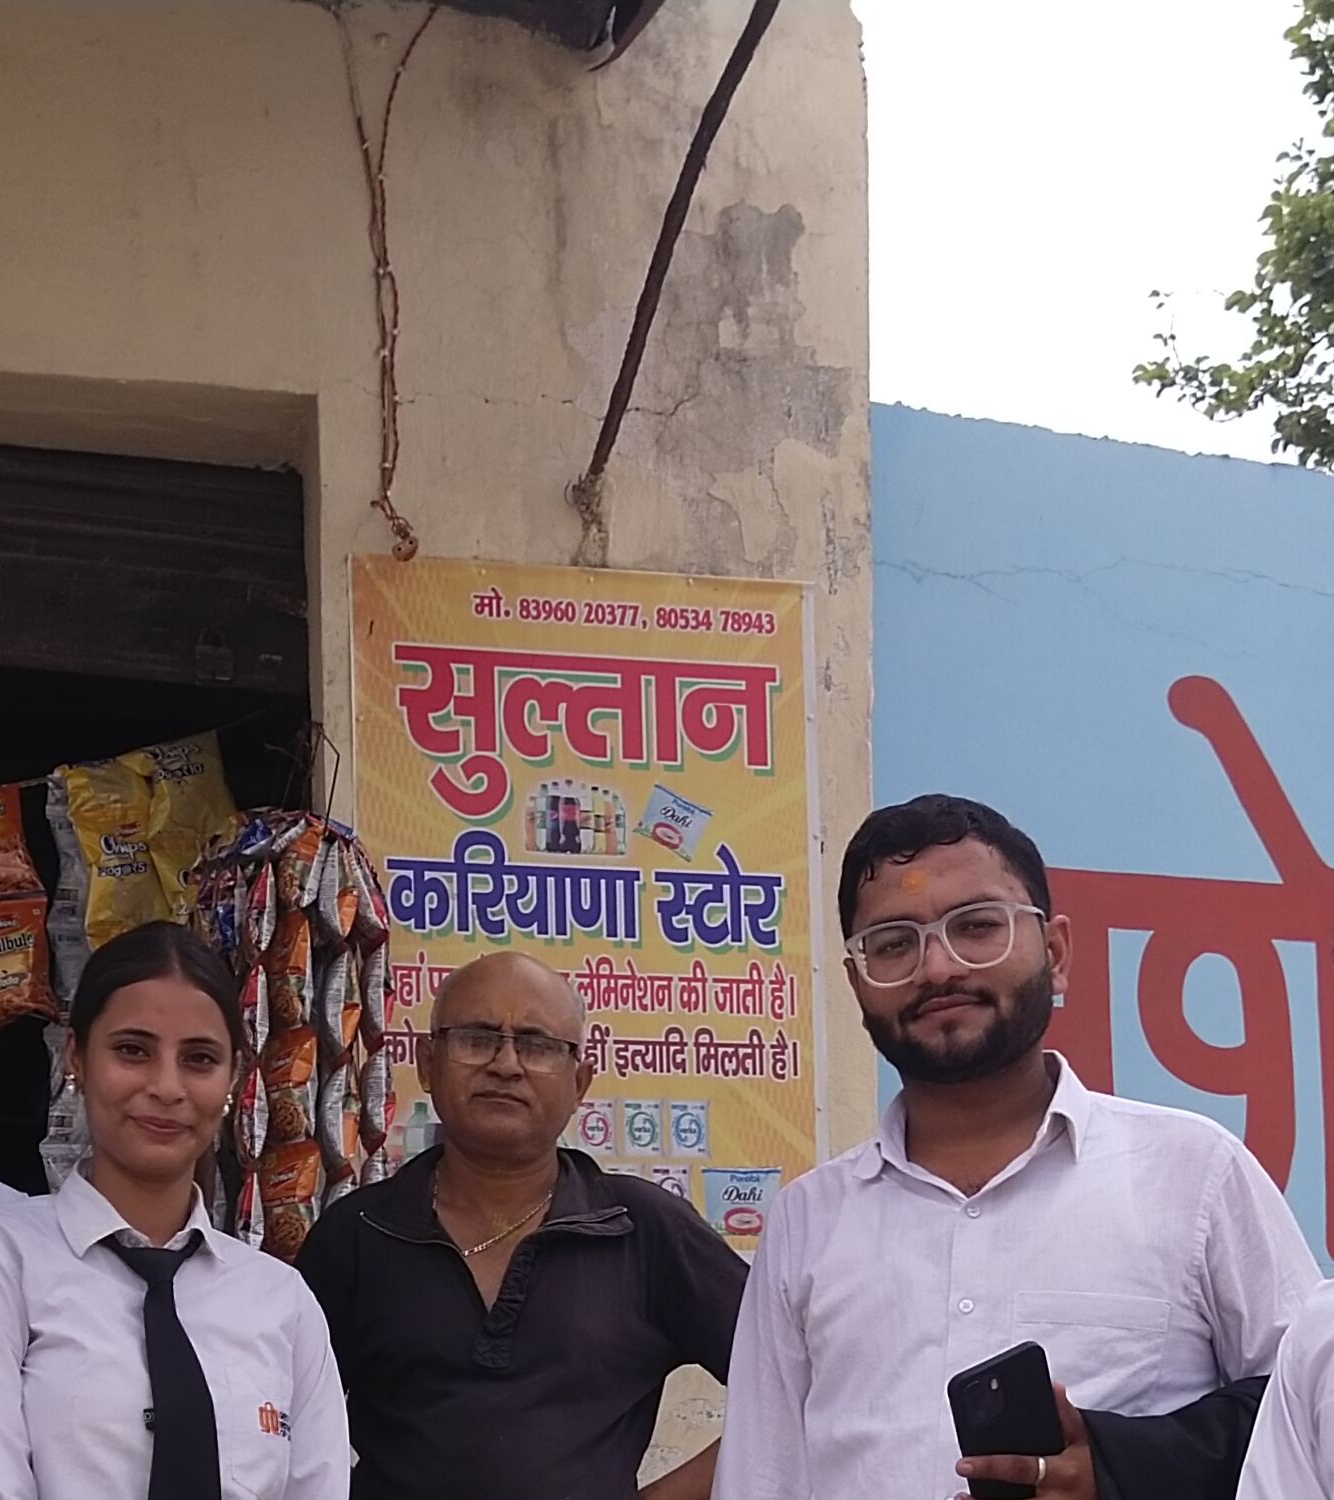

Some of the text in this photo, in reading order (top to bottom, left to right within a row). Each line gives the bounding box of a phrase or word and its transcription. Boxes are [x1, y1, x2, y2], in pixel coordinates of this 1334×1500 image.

[472, 587, 776, 635] मो. 83960 20377, 80534 78943
[394, 643, 782, 816] सुल्तान
[99, 834, 149, 859] Chips
[386, 830, 783, 947] करियाणा स्टोर
[574, 957, 672, 1013] लेमिनेशन
[680, 960, 708, 1014] की
[714, 963, 765, 1016] जाती
[614, 1027, 688, 1078] इत्यादि
[694, 1028, 766, 1078] मिलती
[721, 1185, 764, 1203] Dahi
